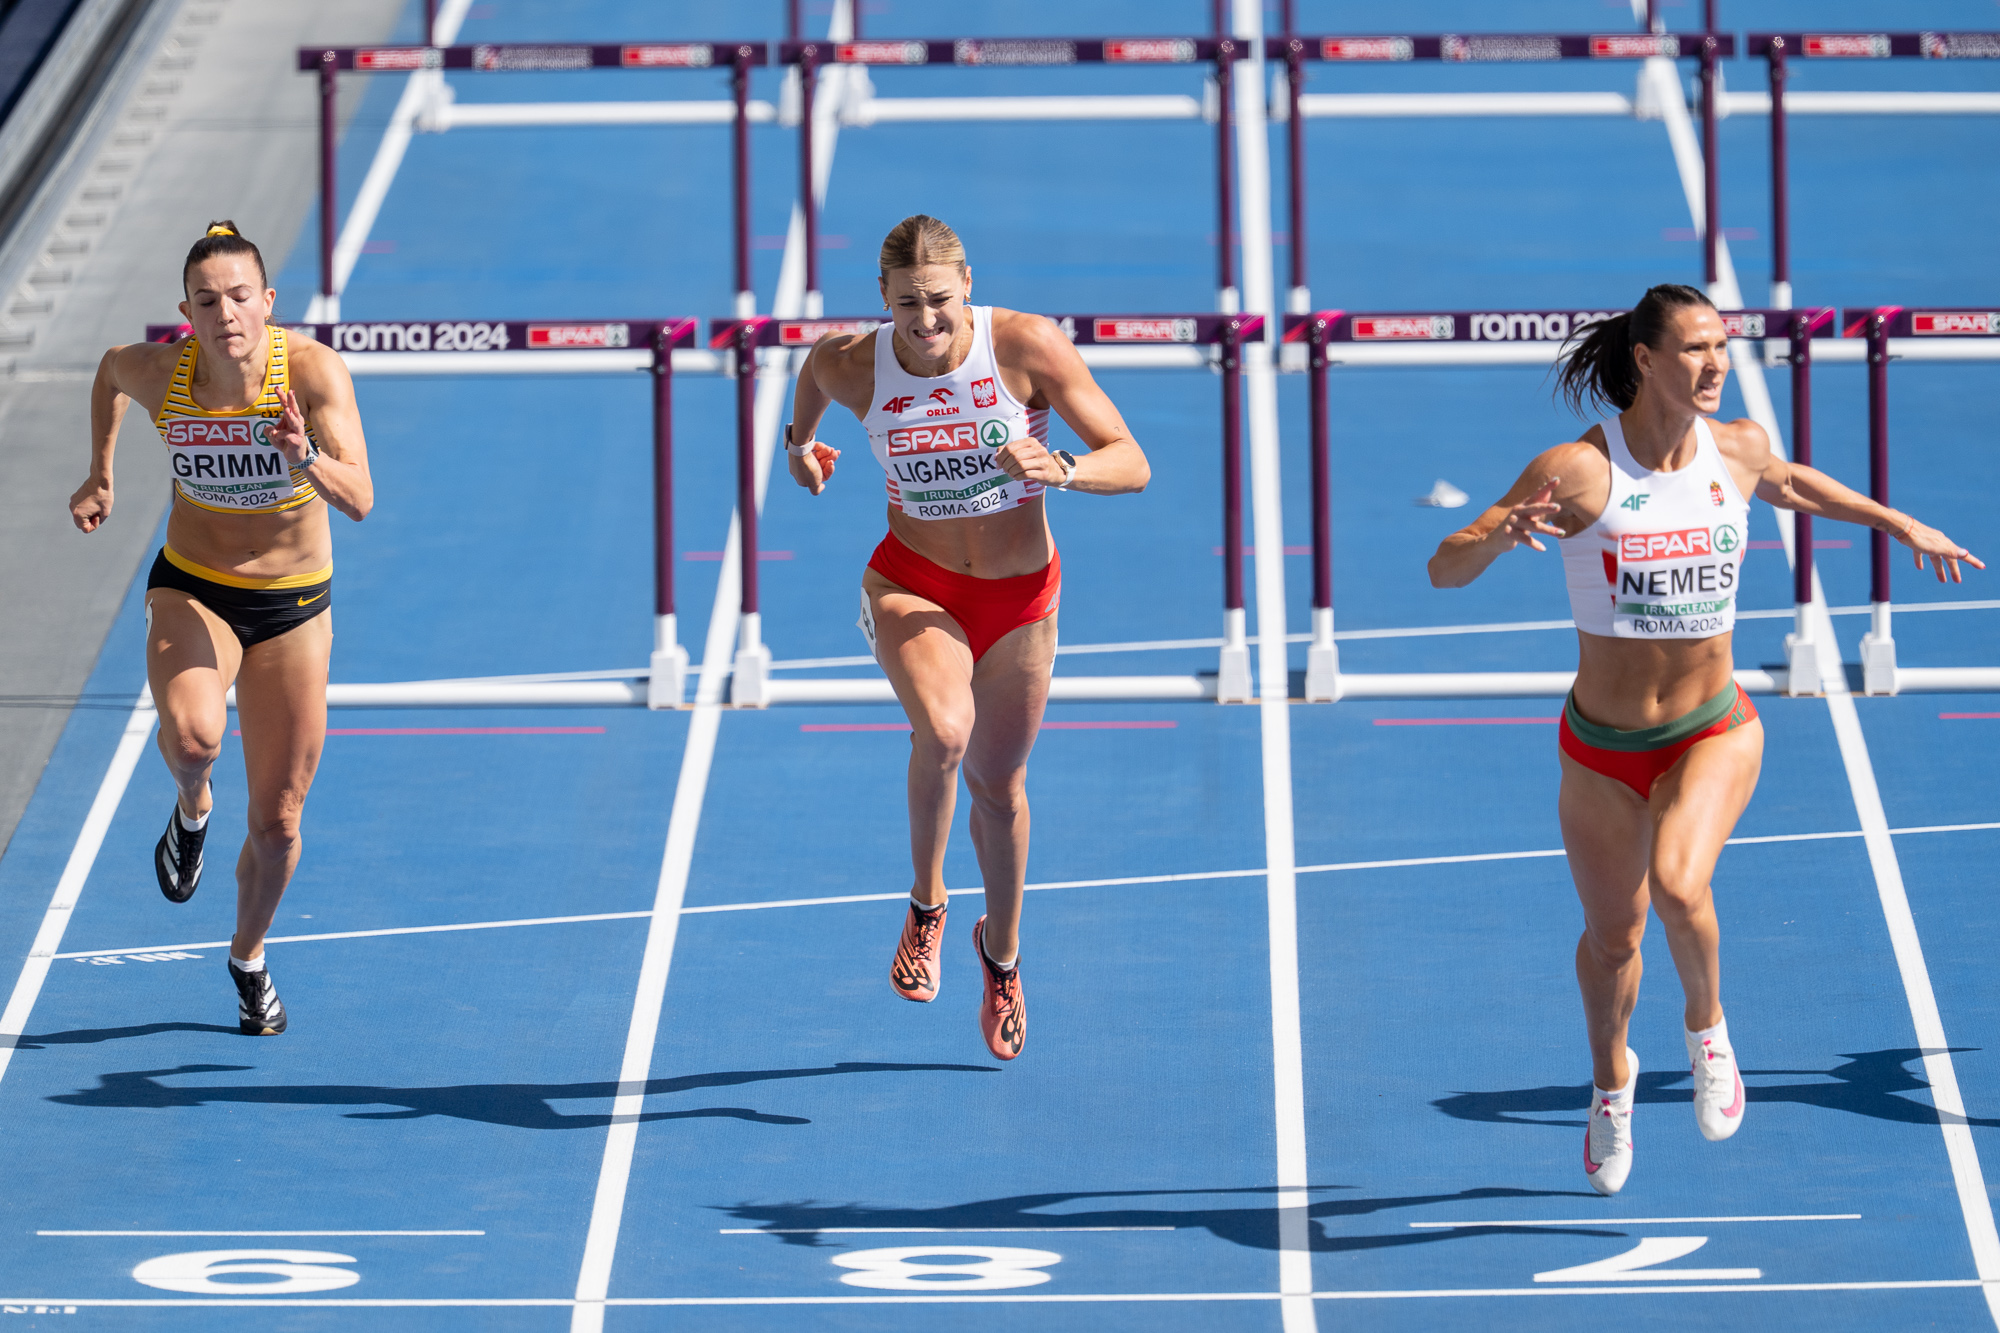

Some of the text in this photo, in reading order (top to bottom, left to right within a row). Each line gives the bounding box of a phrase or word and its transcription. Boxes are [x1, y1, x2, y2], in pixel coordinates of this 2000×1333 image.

[1114, 321, 1171, 339] SPAR
[1372, 319, 1430, 337] SPAR
[1470, 313, 1569, 340] roma
[1932, 315, 1987, 332] SPAR
[332, 322, 510, 351] roma 2024
[550, 325, 604, 344] SPAR
[926, 406, 960, 417] ORLEN
[168, 423, 249, 442] SPAR
[890, 425, 976, 453] SPAR
[172, 452, 282, 478] GRIMM
[893, 453, 997, 484] LIGARSK
[193, 489, 278, 506] ROMA 2024
[201, 485, 224, 493] RUN
[931, 490, 955, 501] RUN
[918, 488, 1009, 517] ROMA 2024
[1623, 530, 1711, 559] SPAR
[1622, 562, 1734, 596] NEMES
[1650, 605, 1676, 616] RUN
[1634, 616, 1724, 633] ROMA 2024
[831, 1245, 1062, 1291] 8
